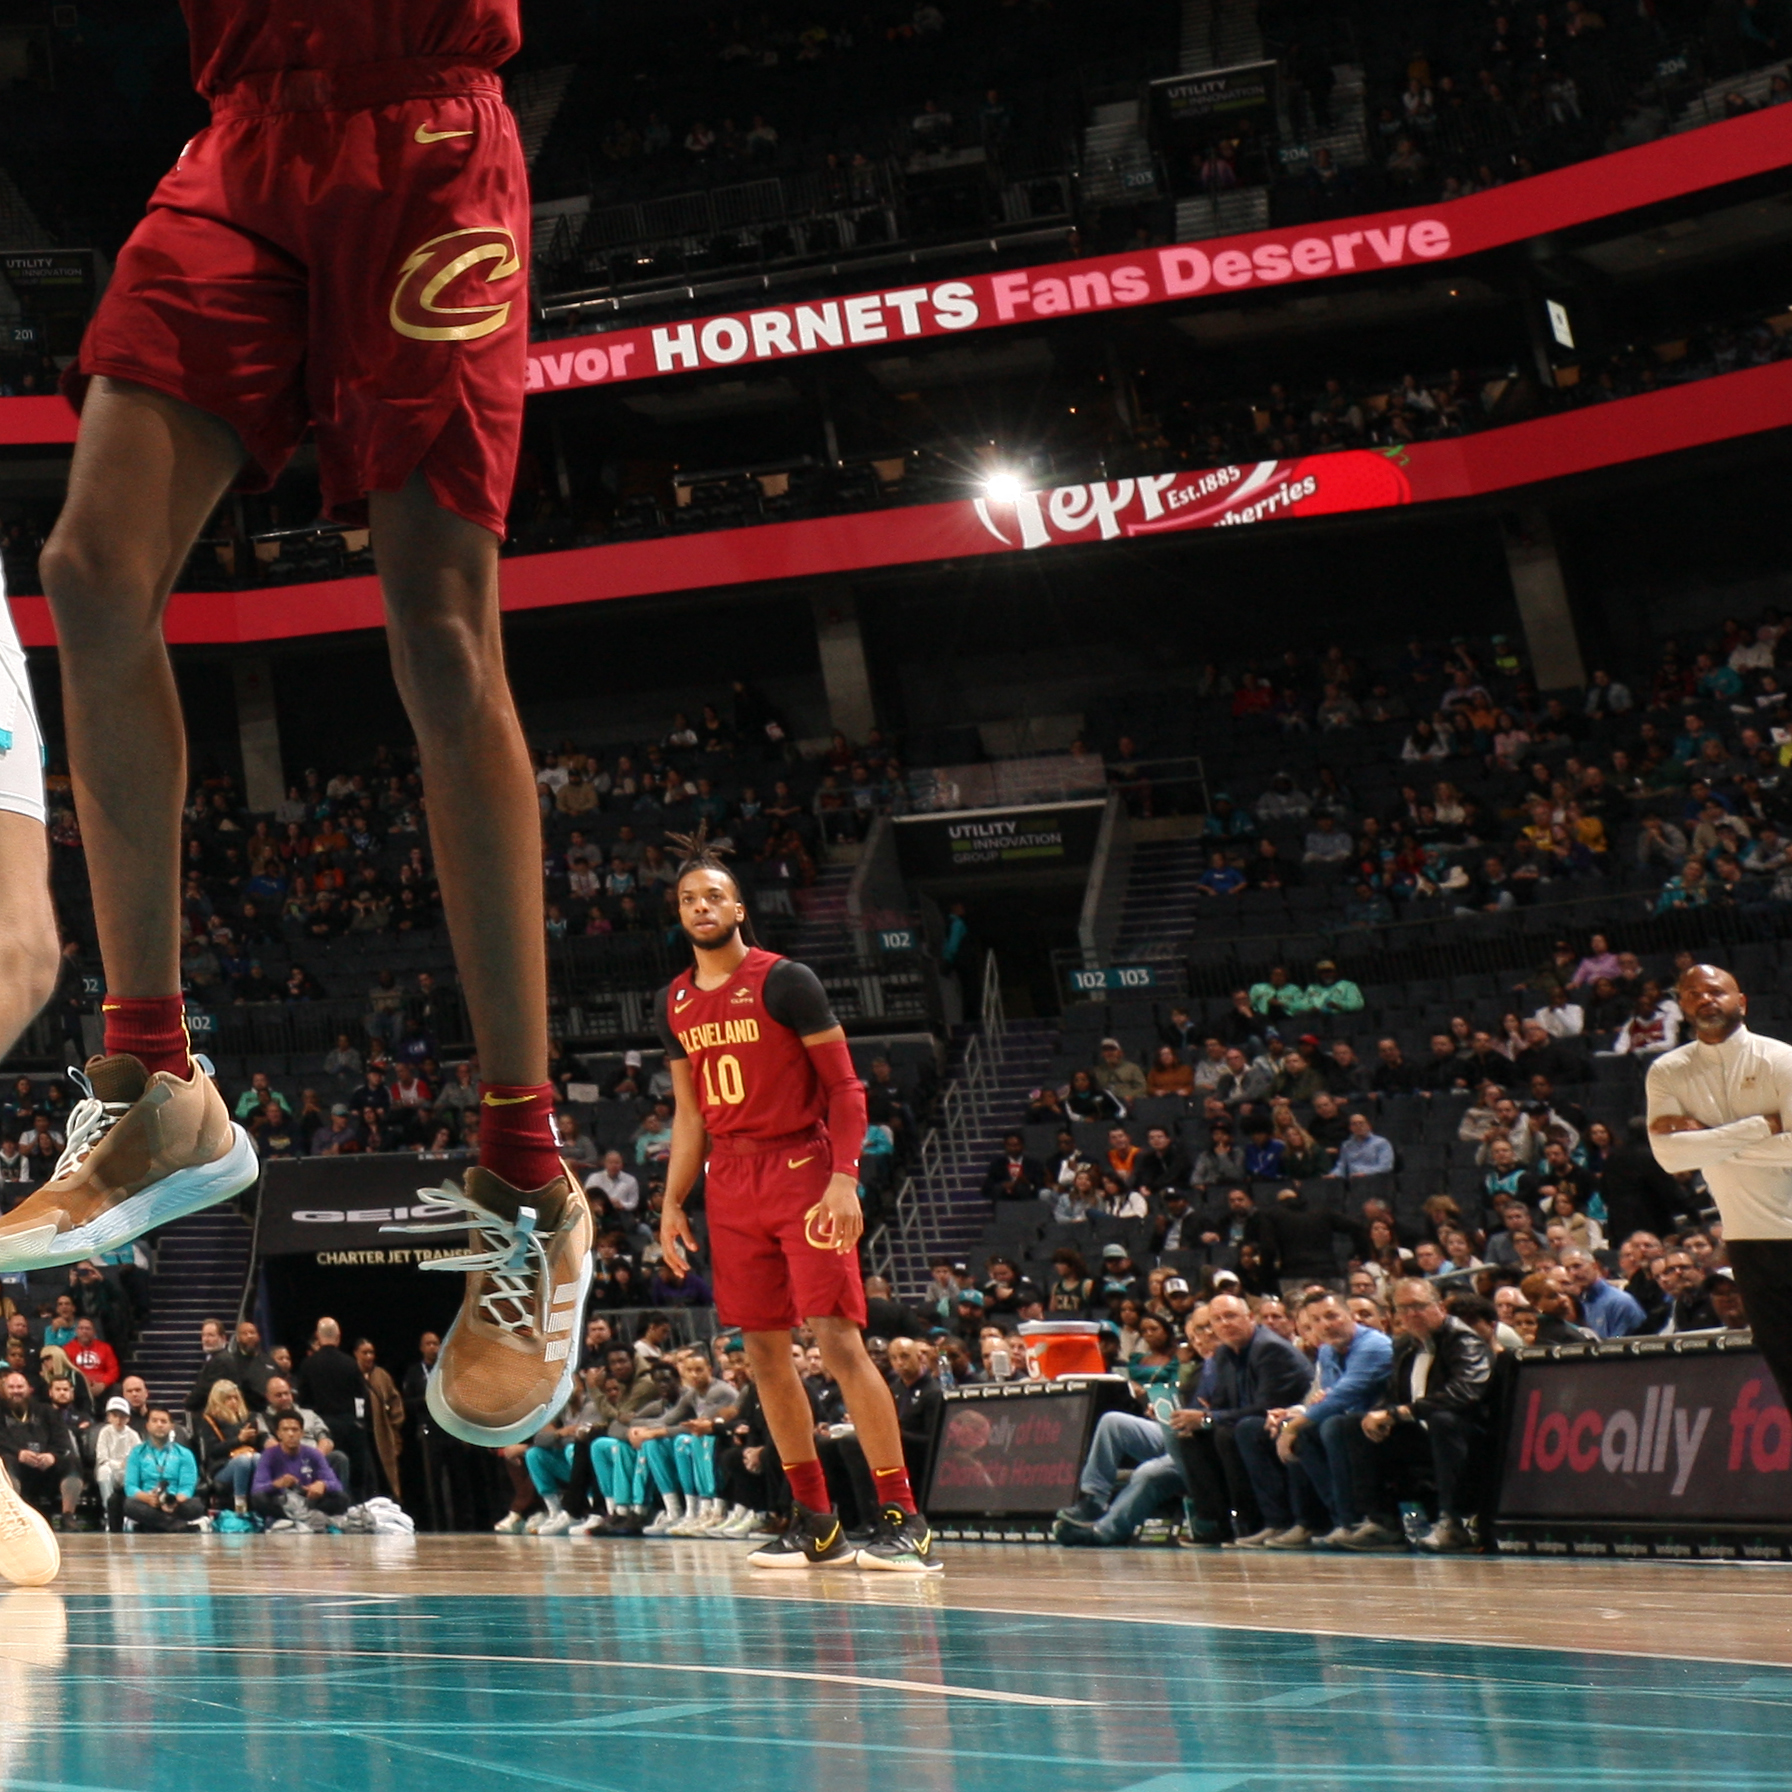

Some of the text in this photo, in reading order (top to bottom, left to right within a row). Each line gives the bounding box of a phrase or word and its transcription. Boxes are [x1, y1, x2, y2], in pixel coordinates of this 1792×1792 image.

[6, 258, 54, 269] UTILITY
[652, 282, 979, 372] HORNETS
[991, 265, 1150, 320] Fans
[1158, 219, 1452, 296] Deserve
[14, 329, 34, 341] 201
[1166, 465, 1241, 511] Est.1885
[949, 820, 1016, 839] UTILITY
[972, 833, 1062, 850] INNOVATION
[882, 932, 911, 948] 102
[1076, 969, 1150, 988] 102 103
[678, 1018, 760, 1055] CLEVELAND
[702, 1054, 746, 1105] 10
[317, 1249, 386, 1266] CHARTER
[387, 1249, 413, 1264] JET
[1519, 1385, 1713, 1496] locally
